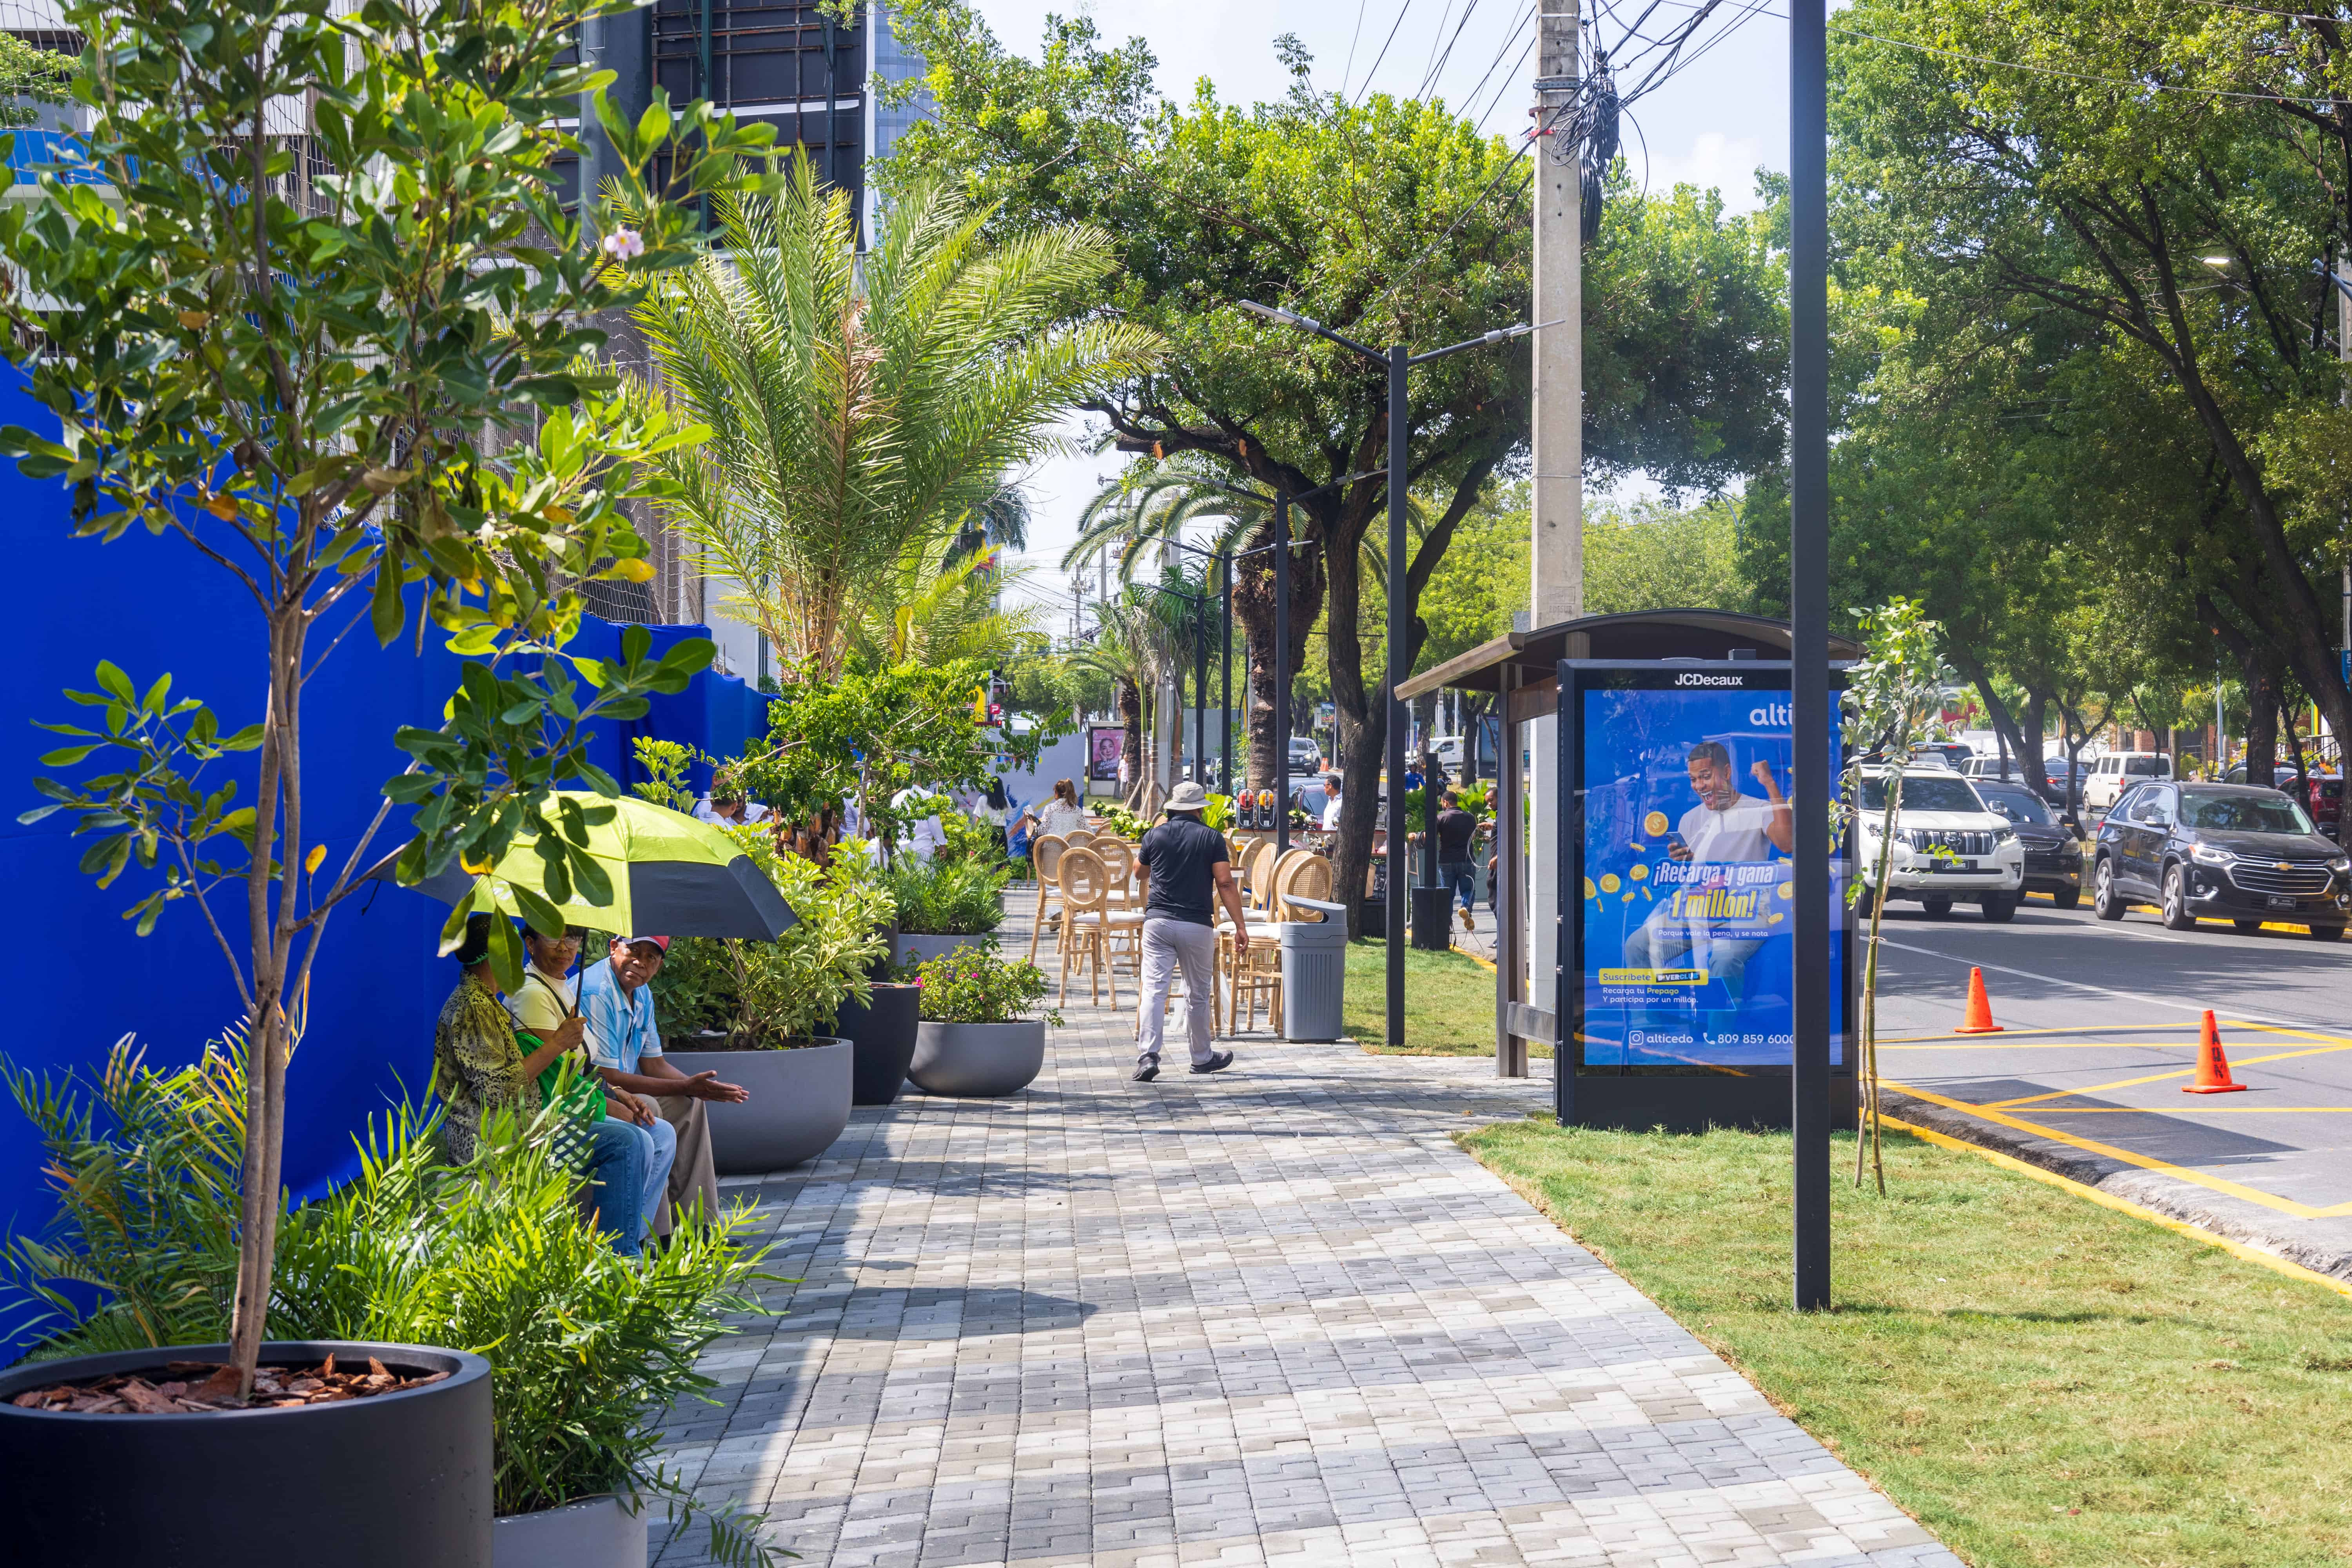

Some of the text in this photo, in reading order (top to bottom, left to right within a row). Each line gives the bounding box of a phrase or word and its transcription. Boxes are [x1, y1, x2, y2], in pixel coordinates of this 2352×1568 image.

[1675, 673, 1743, 685] JCDecaux
[1749, 703, 1793, 726] alti
[1653, 862, 1773, 886] ¡Recarga y gana
[1672, 889, 1756, 918] 1 millón!
[1658, 930, 1684, 938] Porque
[1647, 1034, 1693, 1043] alticedo
[1717, 1034, 1739, 1044] 809
[1742, 1034, 1764, 1044] 859
